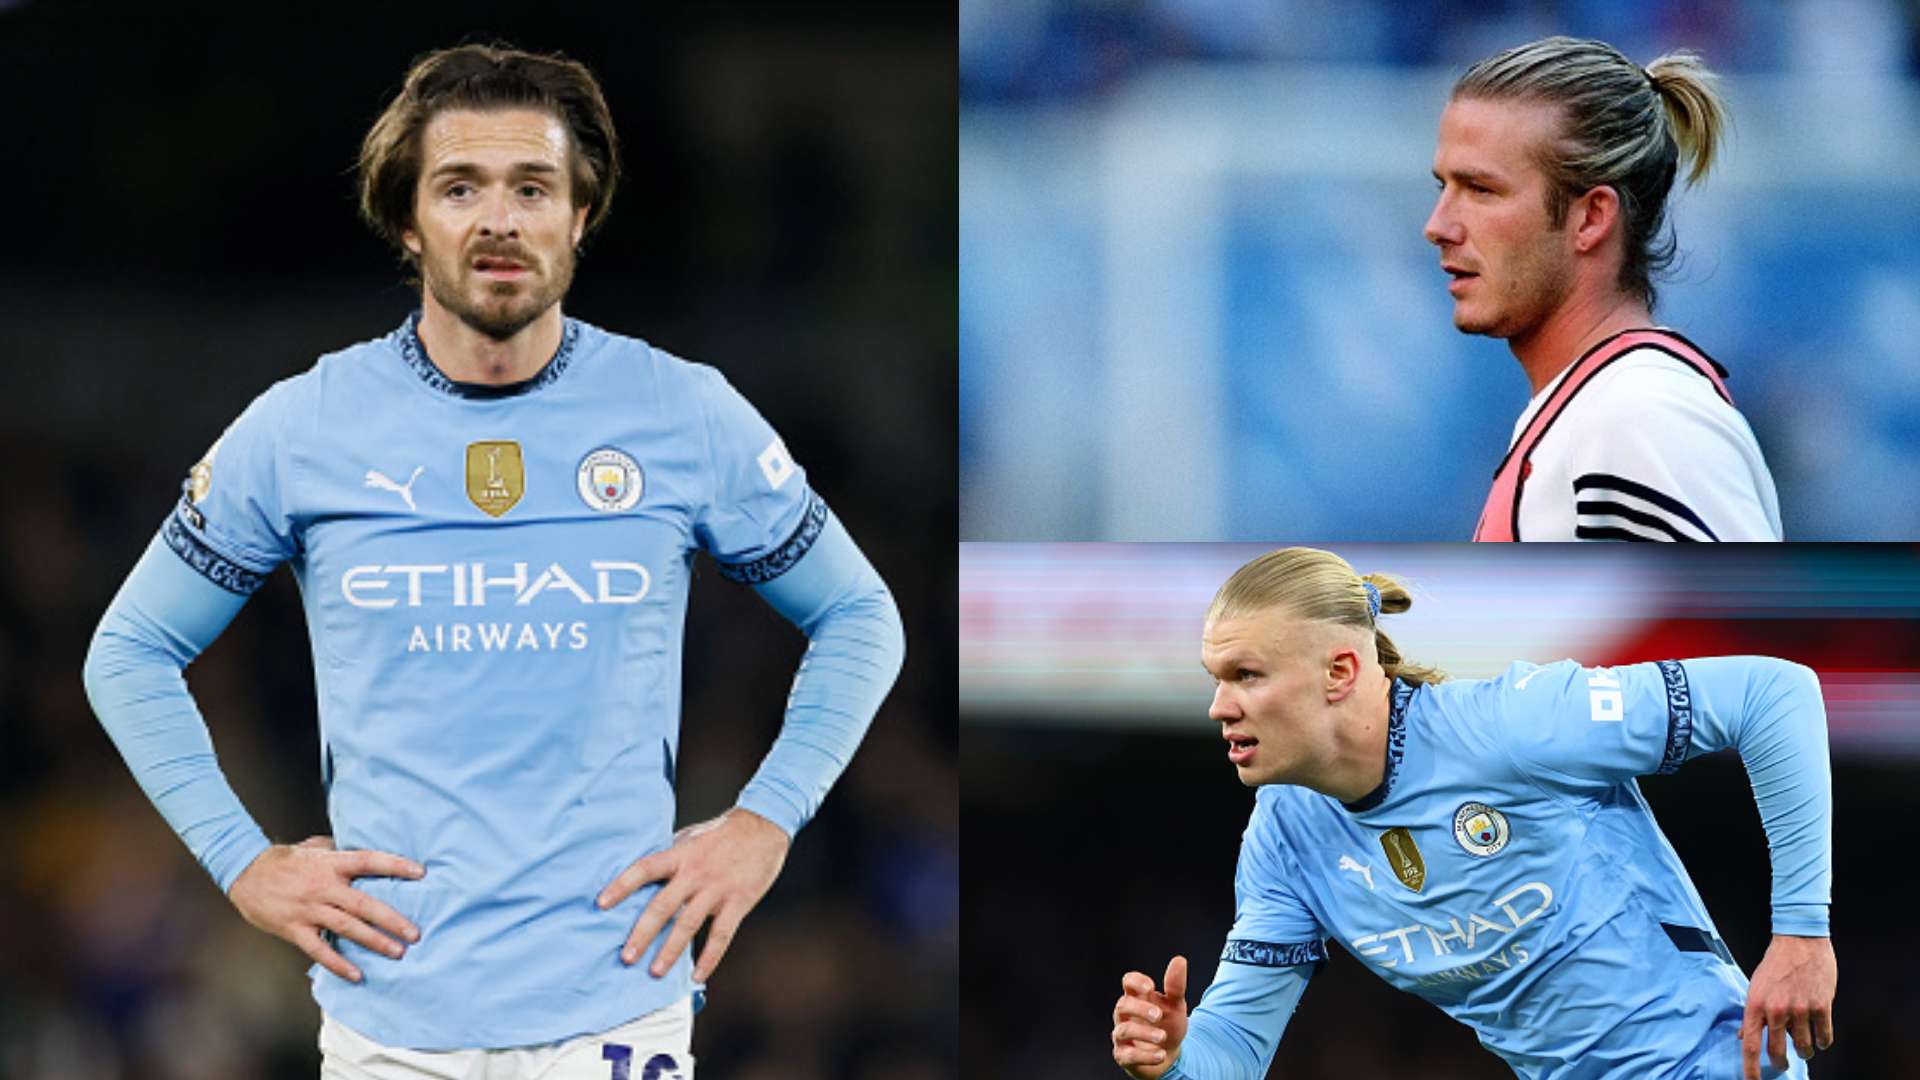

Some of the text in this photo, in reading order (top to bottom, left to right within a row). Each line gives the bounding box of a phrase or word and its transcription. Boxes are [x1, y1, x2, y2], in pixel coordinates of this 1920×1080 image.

[341, 560, 650, 609] ETIHAD
[408, 621, 589, 652] AIRWAYS
[1351, 882, 1553, 968] ETIHAD
